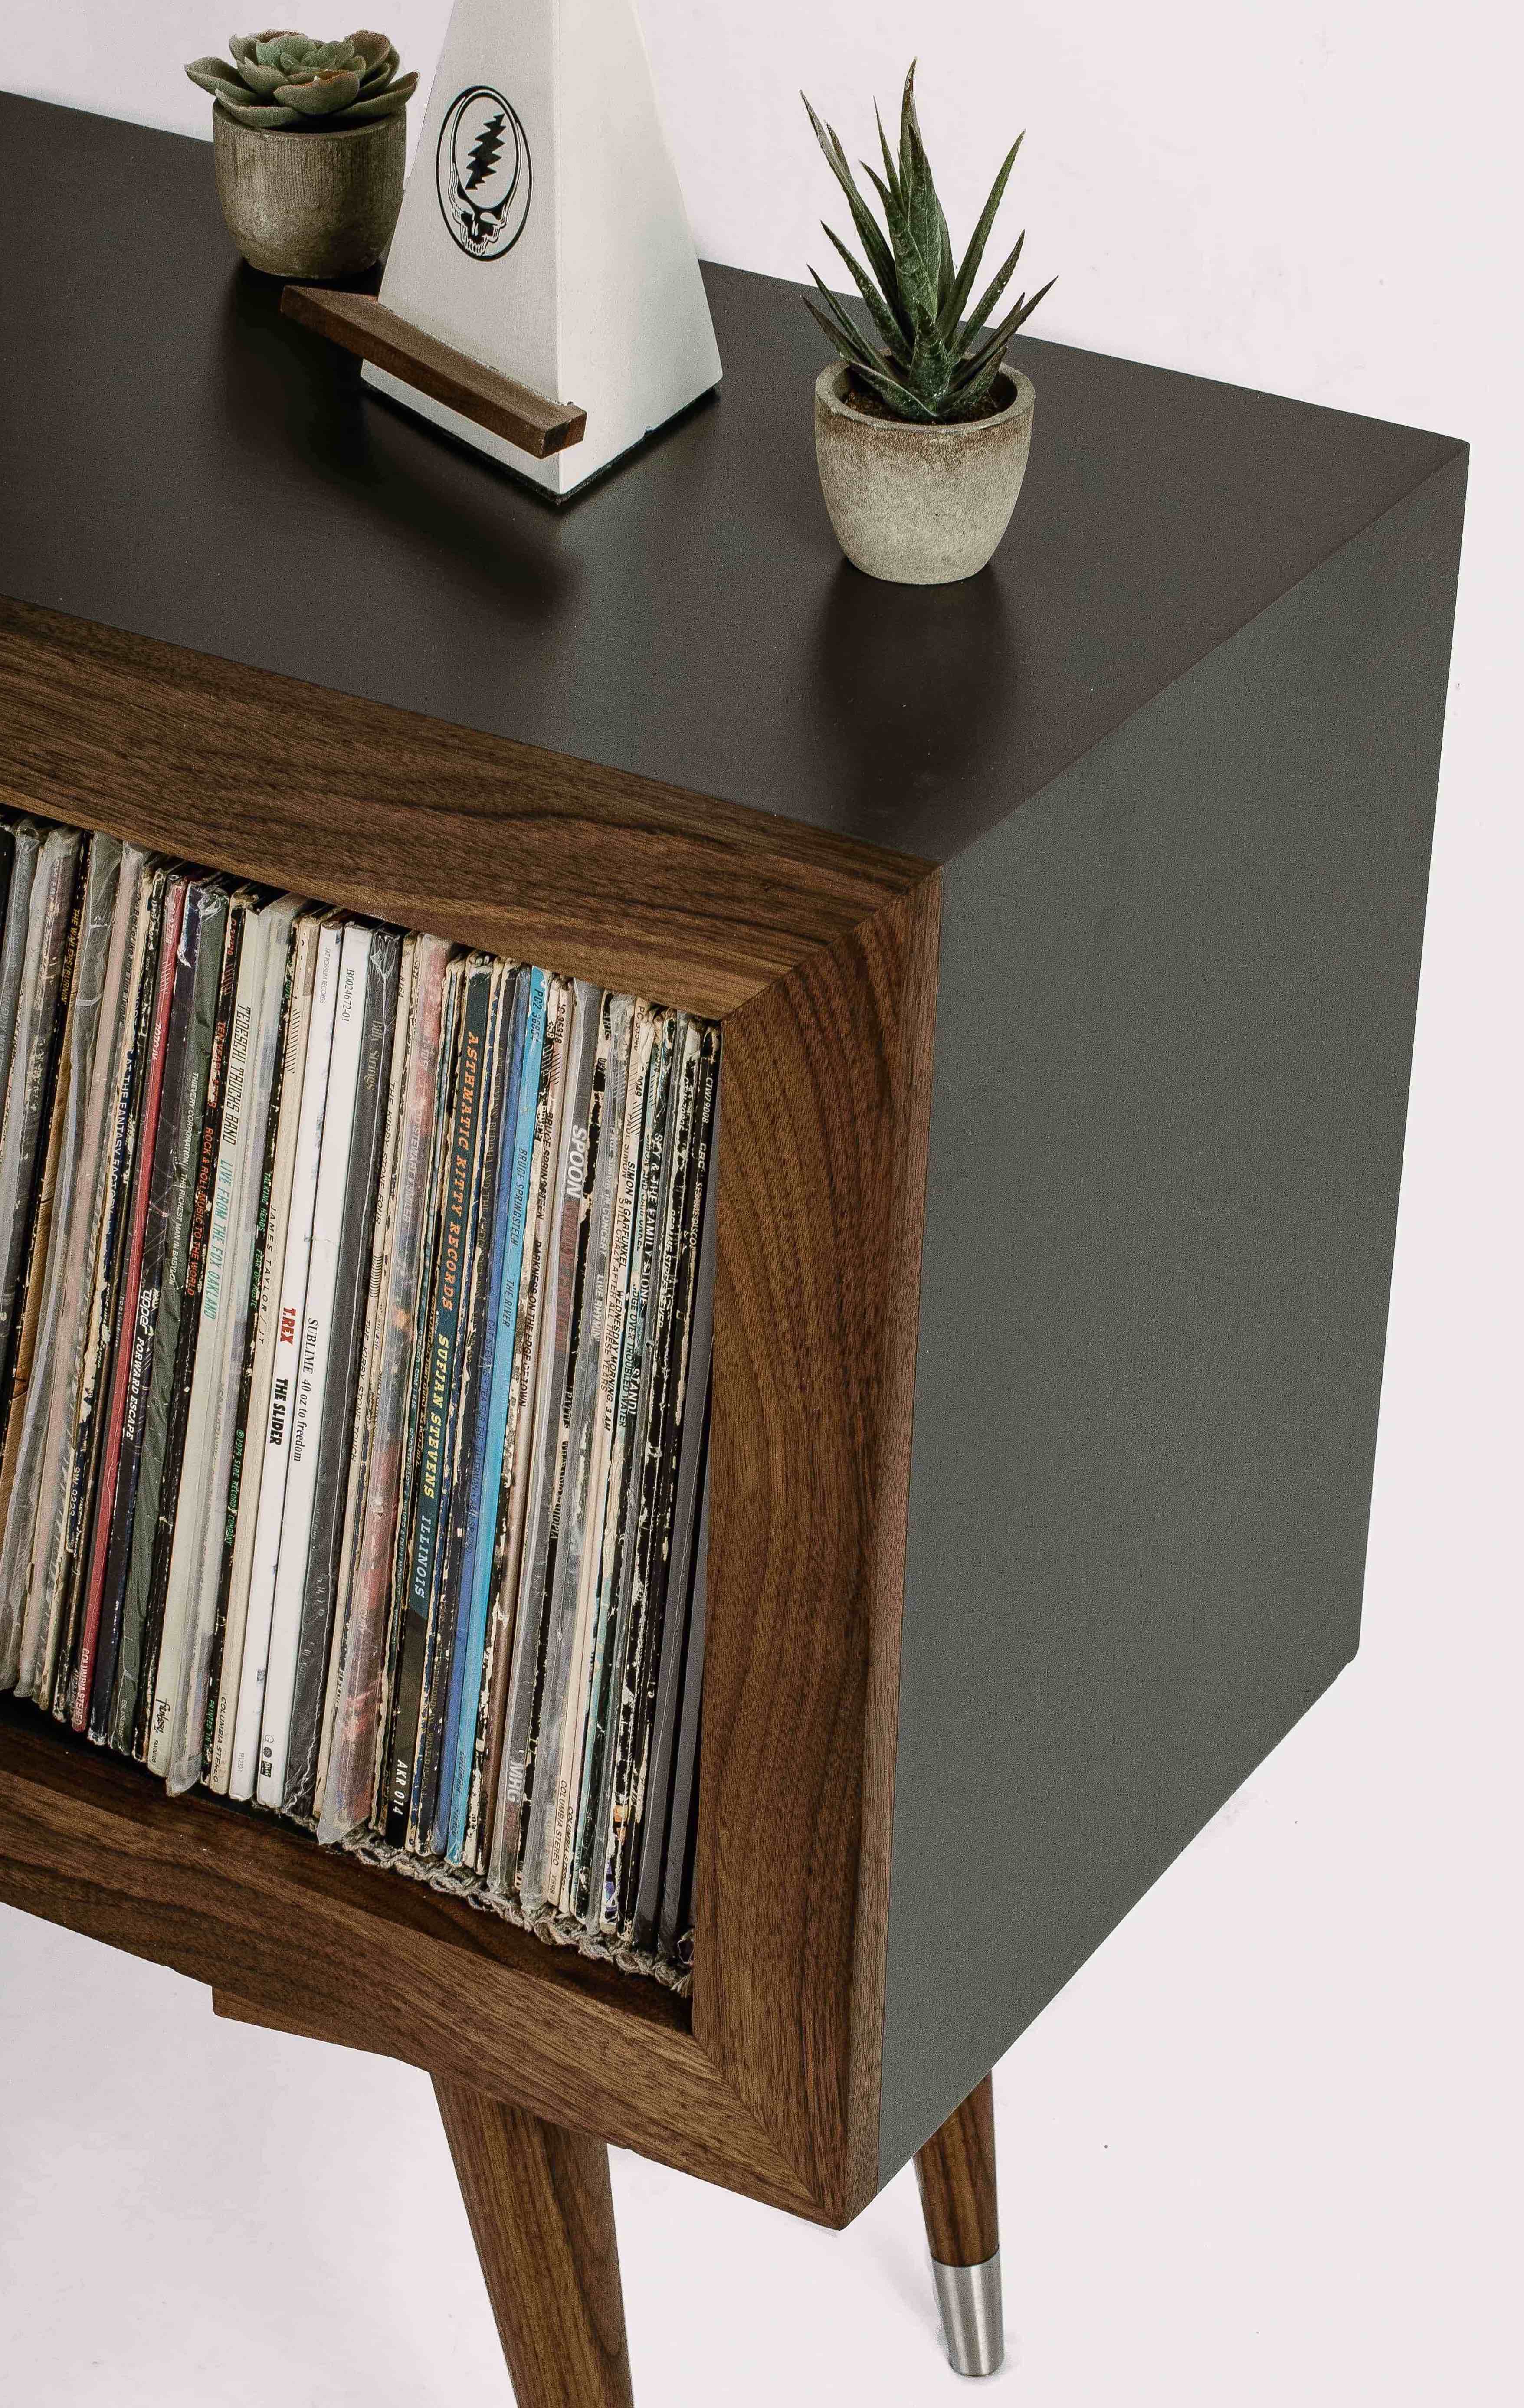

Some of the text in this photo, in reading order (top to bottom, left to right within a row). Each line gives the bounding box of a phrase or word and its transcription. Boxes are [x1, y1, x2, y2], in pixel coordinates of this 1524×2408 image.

[71, 909, 79, 925] THE
[131, 909, 139, 929] Best
[129, 931, 136, 940] of
[125, 957, 133, 974] and
[321, 957, 330, 980] POSSUM
[122, 976, 131, 993] Tina
[319, 981, 328, 1004] RECORDS
[341, 969, 355, 1022] B0024672-01
[532, 989, 543, 1009] PC2
[118, 996, 128, 1025] Turner
[636, 1006, 644, 1020] PC
[150, 1023, 161, 1060] TOTO IV
[216, 1021, 226, 1039] TEN
[123, 1058, 131, 1072] AT
[363, 1021, 383, 1091] Billy Strings
[120, 1075, 129, 1098] THE
[221, 1005, 251, 1146] TEDESCHI TRUCKS BAND
[457, 1032, 479, 1150] ASTHMATIC
[113, 1102, 126, 1156] FANTASY
[182, 1072, 198, 1164] THIEVERY CORPORATION
[543, 1112, 553, 1147] BRUCE
[624, 1114, 633, 1140] PAUL
[203, 1128, 213, 1156] ROCK
[374, 1082, 395, 1225] THE KIRBY STONE FOUR
[651, 1132, 663, 1160] SLY
[198, 1166, 209, 1192] ROLL
[402, 1127, 420, 1222] STEWART SMILER
[566, 1125, 588, 1198] SPOON
[624, 1161, 636, 1196] SIMON
[450, 1155, 467, 1217] KITTY
[509, 1148, 528, 1246] BRUCE SPRINGSTEEN
[536, 1149, 549, 1220] SPRINGSTEEN
[646, 1176, 659, 1202] THE
[195, 1193, 206, 1222] MUSIC
[616, 1197, 625, 1226] STILL
[168, 1174, 187, 1285] THE RICHEST MAN IN BABYLON
[193, 1226, 202, 1238] TO
[202, 1159, 233, 1320] LIVE FROM THE FOX OAKLAND
[249, 1173, 272, 1308] TALKING HEADS FEAR OF MUSIC
[598, 1207, 611, 1256] CONCERT
[613, 1229, 622, 1262] CRAZY
[618, 1208, 631, 1268] GARFUNKEL
[641, 1208, 655, 1256] FAMILY
[190, 1242, 200, 1258] THE
[441, 1222, 461, 1310] RECORDS
[528, 1240, 541, 1293] DARKNESS
[187, 1261, 198, 1295] WORLD
[257, 1205, 277, 1345] JAMES TAYLOR JT
[594, 1274, 605, 1298] LIVE
[609, 1266, 619, 1298] AFTER
[636, 1263, 650, 1304] STONE
[501, 1280, 514, 1327] THE RIVER
[527, 1296, 535, 1308] ON
[607, 1301, 615, 1320] ALL
[279, 1307, 296, 1345] T.REX
[486, 1320, 495, 1338] CAT
[525, 1313, 534, 1332] THE
[603, 1323, 613, 1354] THESE
[610, 1290, 623, 1352] WEDNESDAY
[522, 1334, 532, 1361] EDGE
[432, 1334, 450, 1408] SUFJAN
[600, 1357, 610, 1391] YEARS
[618, 1314, 636, 1427] OVER TROUBLED WATER
[125, 1337, 144, 1440] FORWARD ESCAPE
[292, 1318, 318, 1462] SUBLIME 40 oz to freedom
[349, 1319, 370, 1462] THE KIRBY STONE TOUCH
[479, 1387, 488, 1404] TEA
[518, 1379, 528, 1406] TOWN
[626, 1367, 640, 1415] STAND!
[269, 1378, 288, 1445] THE SLIDER
[478, 1405, 486, 1422] FOR
[603, 1414, 611, 1430] AM
[475, 1425, 485, 1442] THE
[231, 1459, 241, 1476] SIRE
[423, 1412, 442, 1498] STEVENS
[471, 1445, 482, 1491] TILLERMAN
[228, 1481, 239, 1510] RECORDS
[413, 1515, 432, 1598] ILLINOIS
[73, 1648, 89, 1725] COLUMBIA STEREO
[205, 1700, 214, 1729] PRINTED
[204, 1733, 211, 1743] IN
[212, 1697, 227, 1782] COLUMBIA STEREO
[392, 1759, 408, 1815] AKR 014
[455, 1751, 466, 1793] COLUMBIA
[506, 1759, 525, 1804] MRG
[551, 1781, 567, 1866] COLUMBIA STEREO
[564, 1806, 574, 1852] COLUMBIA
